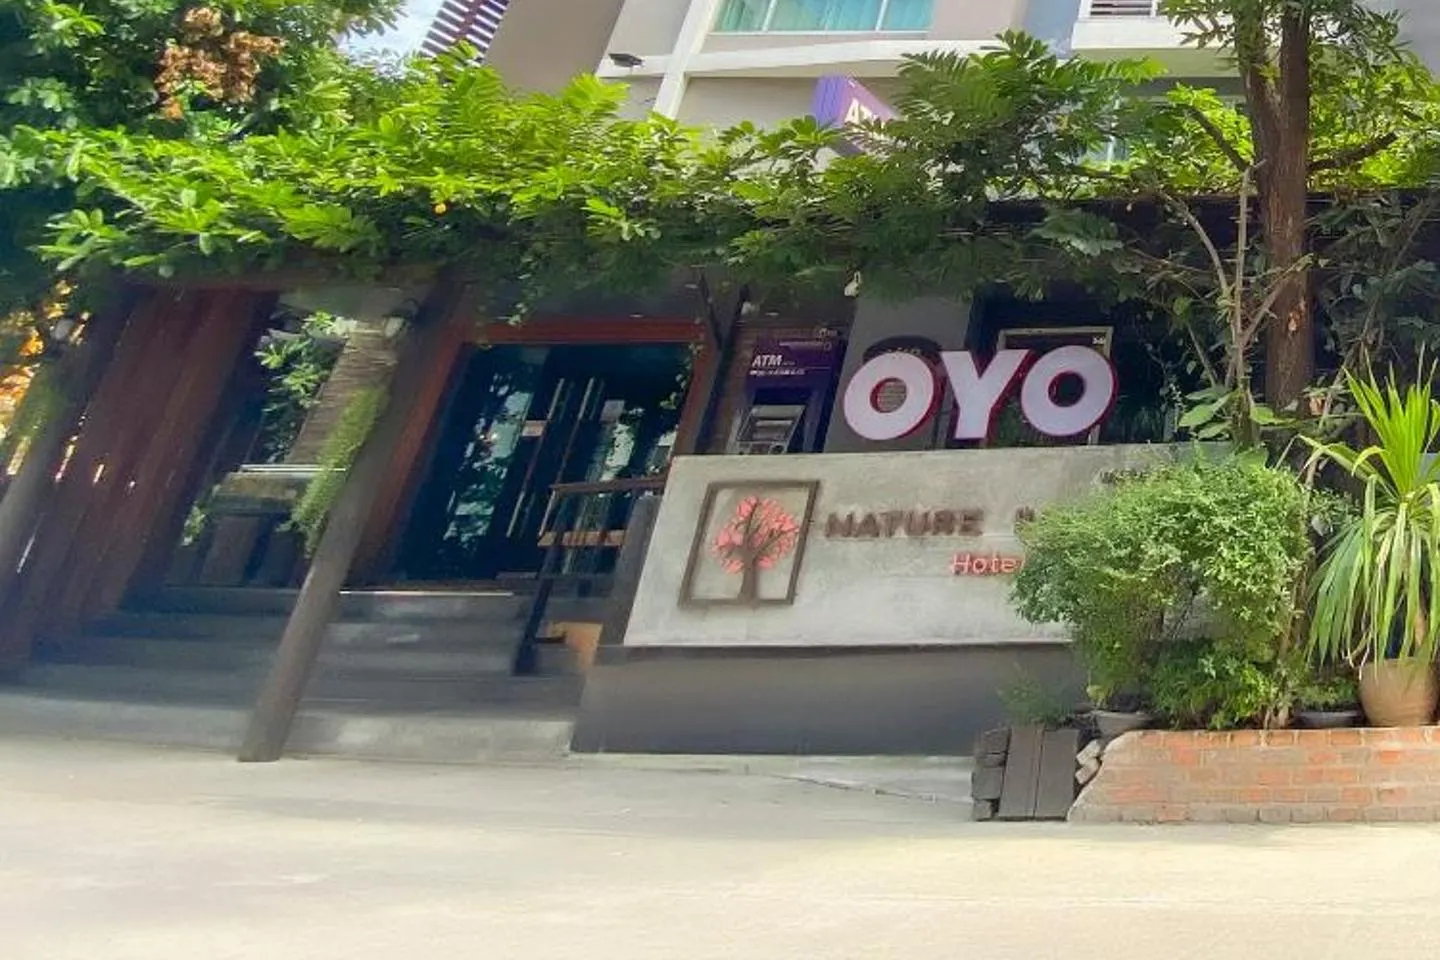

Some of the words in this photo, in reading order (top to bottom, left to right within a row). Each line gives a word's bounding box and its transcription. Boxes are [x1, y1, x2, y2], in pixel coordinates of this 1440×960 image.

[752, 354, 783, 367] ATM
[843, 343, 1119, 441] OYO
[824, 508, 984, 537] NATURE
